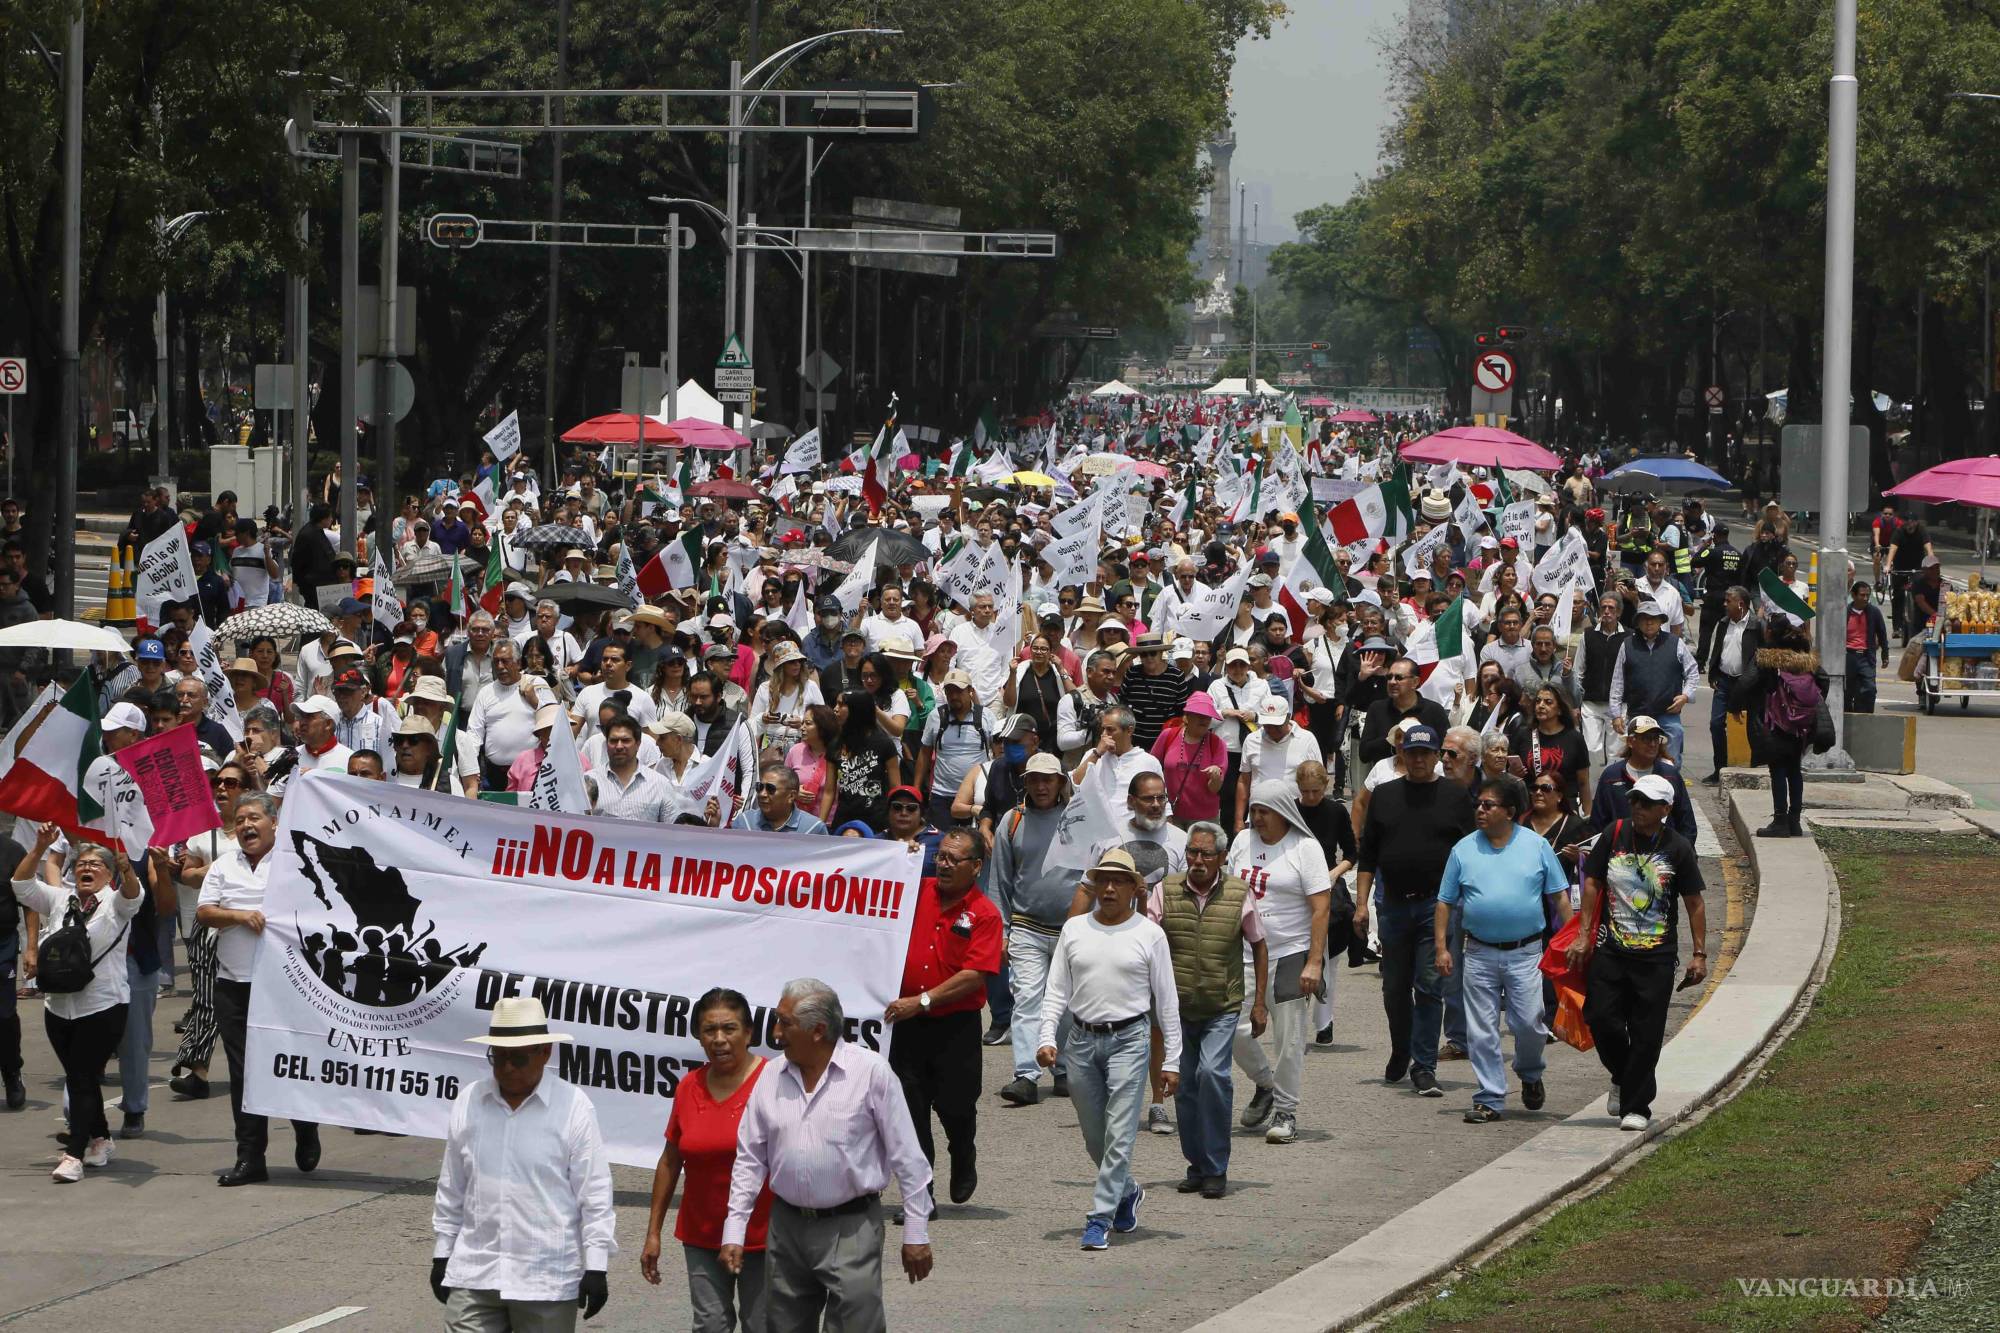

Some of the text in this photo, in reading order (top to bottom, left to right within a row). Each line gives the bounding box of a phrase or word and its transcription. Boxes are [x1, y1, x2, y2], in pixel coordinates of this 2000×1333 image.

[960, 584, 971, 595] no
[134, 755, 155, 776] NO
[154, 748, 190, 812] DEMOCRACIA
[322, 803, 473, 859] MONAIMEX
[592, 847, 616, 886] A
[622, 851, 661, 892] LA
[668, 855, 905, 919] IMPOSICIÓN!!!
[282, 964, 307, 998] PUEBLOS
[312, 1000, 369, 1031] COMUNIDADES
[415, 1018, 424, 1026] DE
[285, 944, 466, 1022] MOVIMIENTO ÚNICO NACIONAL EN DEFENSA DE LOS
[327, 1026, 411, 1058] UNETE
[273, 1053, 460, 1101] CEL. 951 111 55 16
